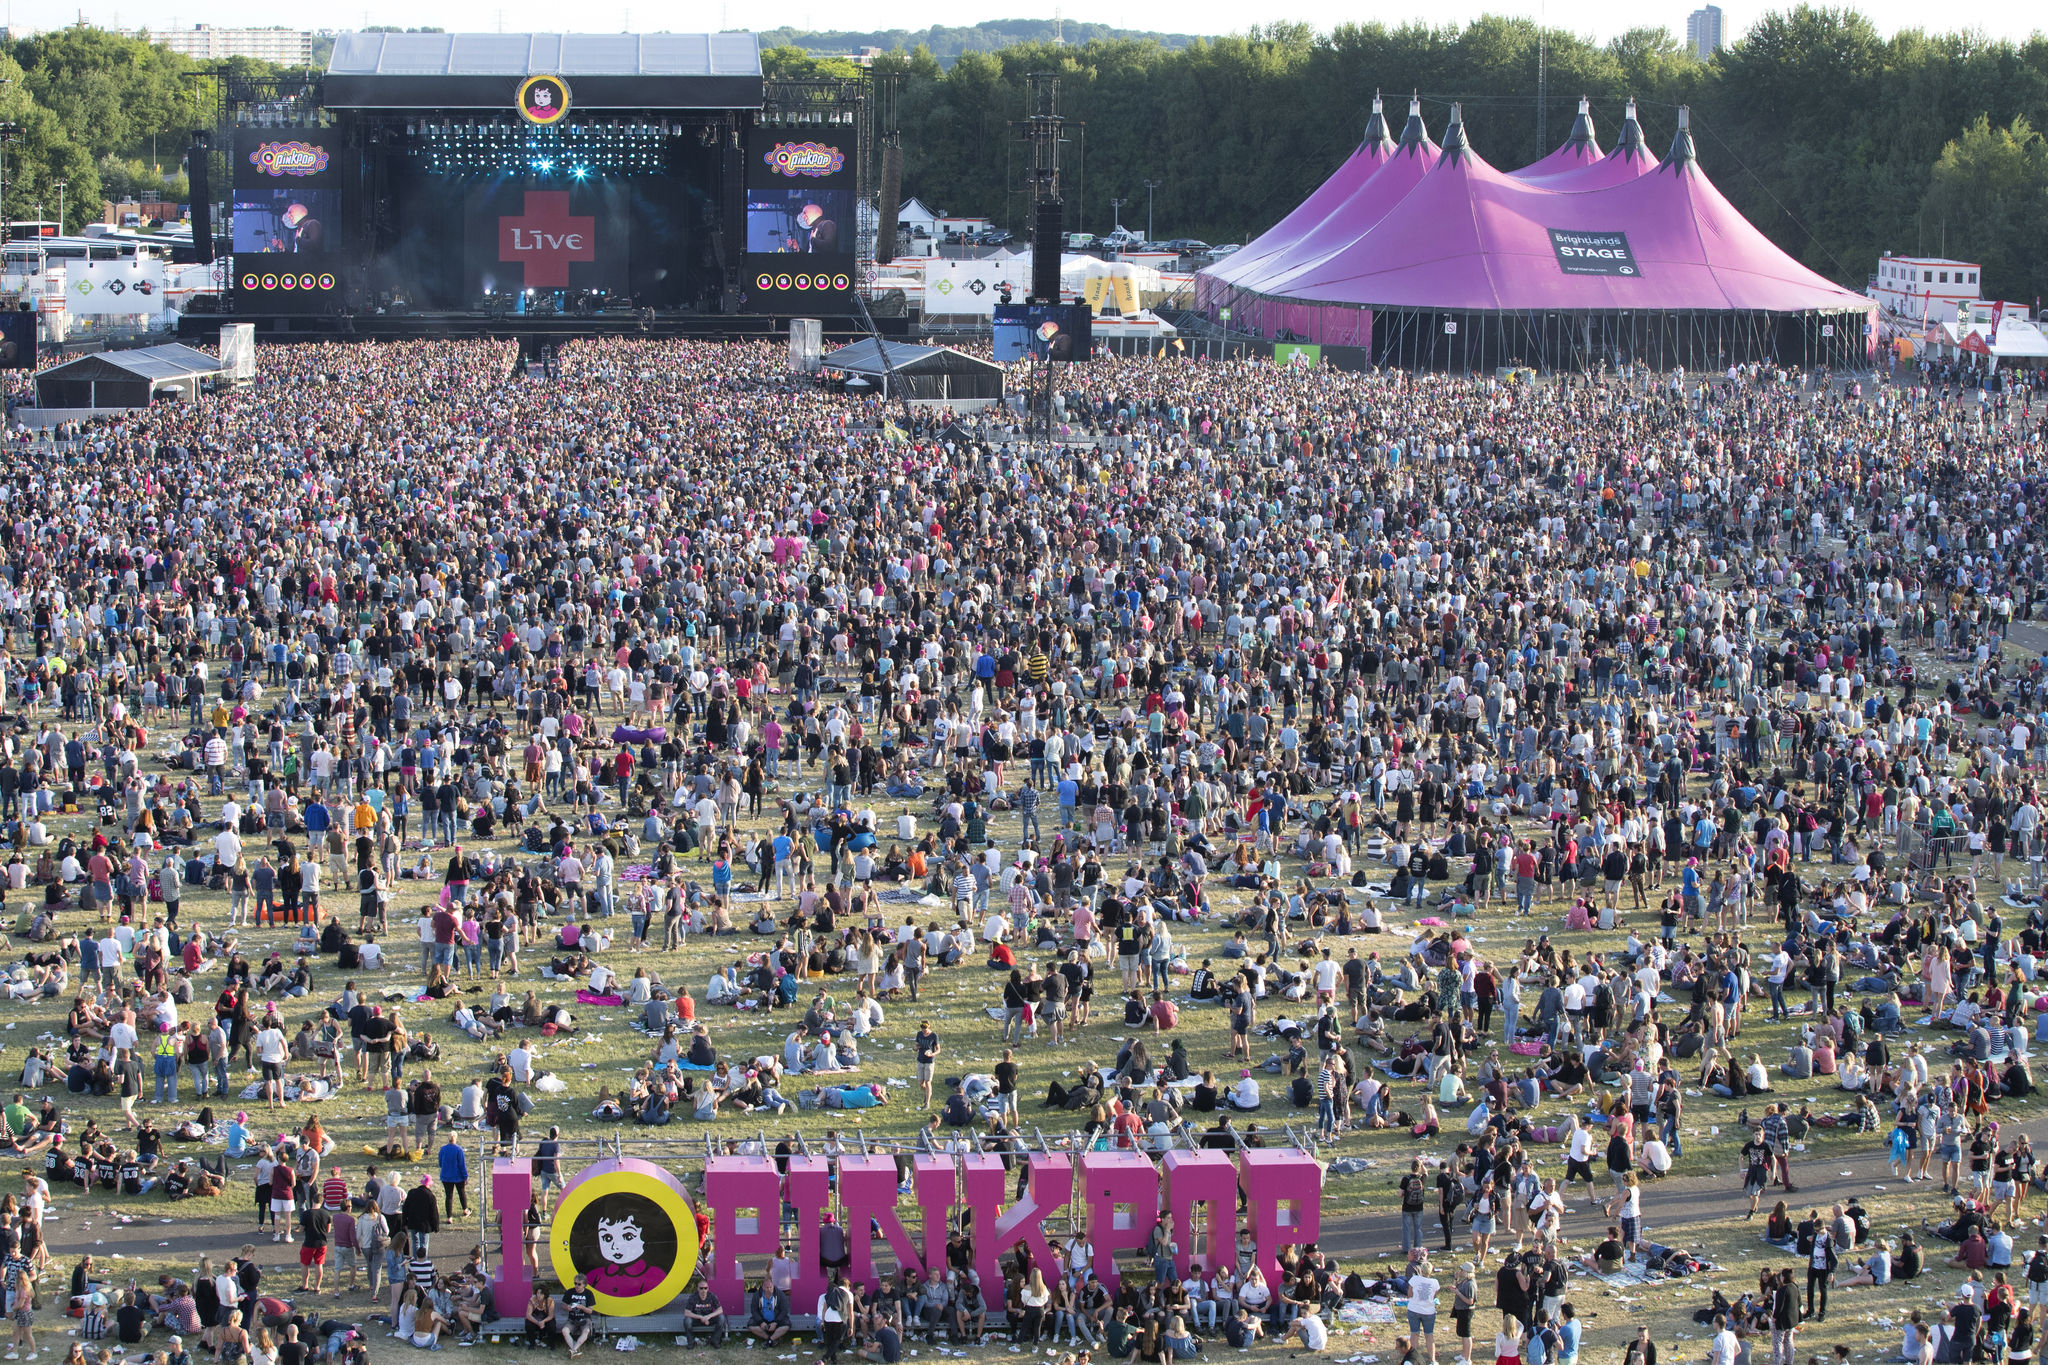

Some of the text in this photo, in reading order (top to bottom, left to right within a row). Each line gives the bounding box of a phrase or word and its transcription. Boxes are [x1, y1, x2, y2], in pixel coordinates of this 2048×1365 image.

[1560, 246, 1627, 259] STAGE
[100, 805, 113, 817] 82
[704, 1149, 1322, 1316] PINKPOP
